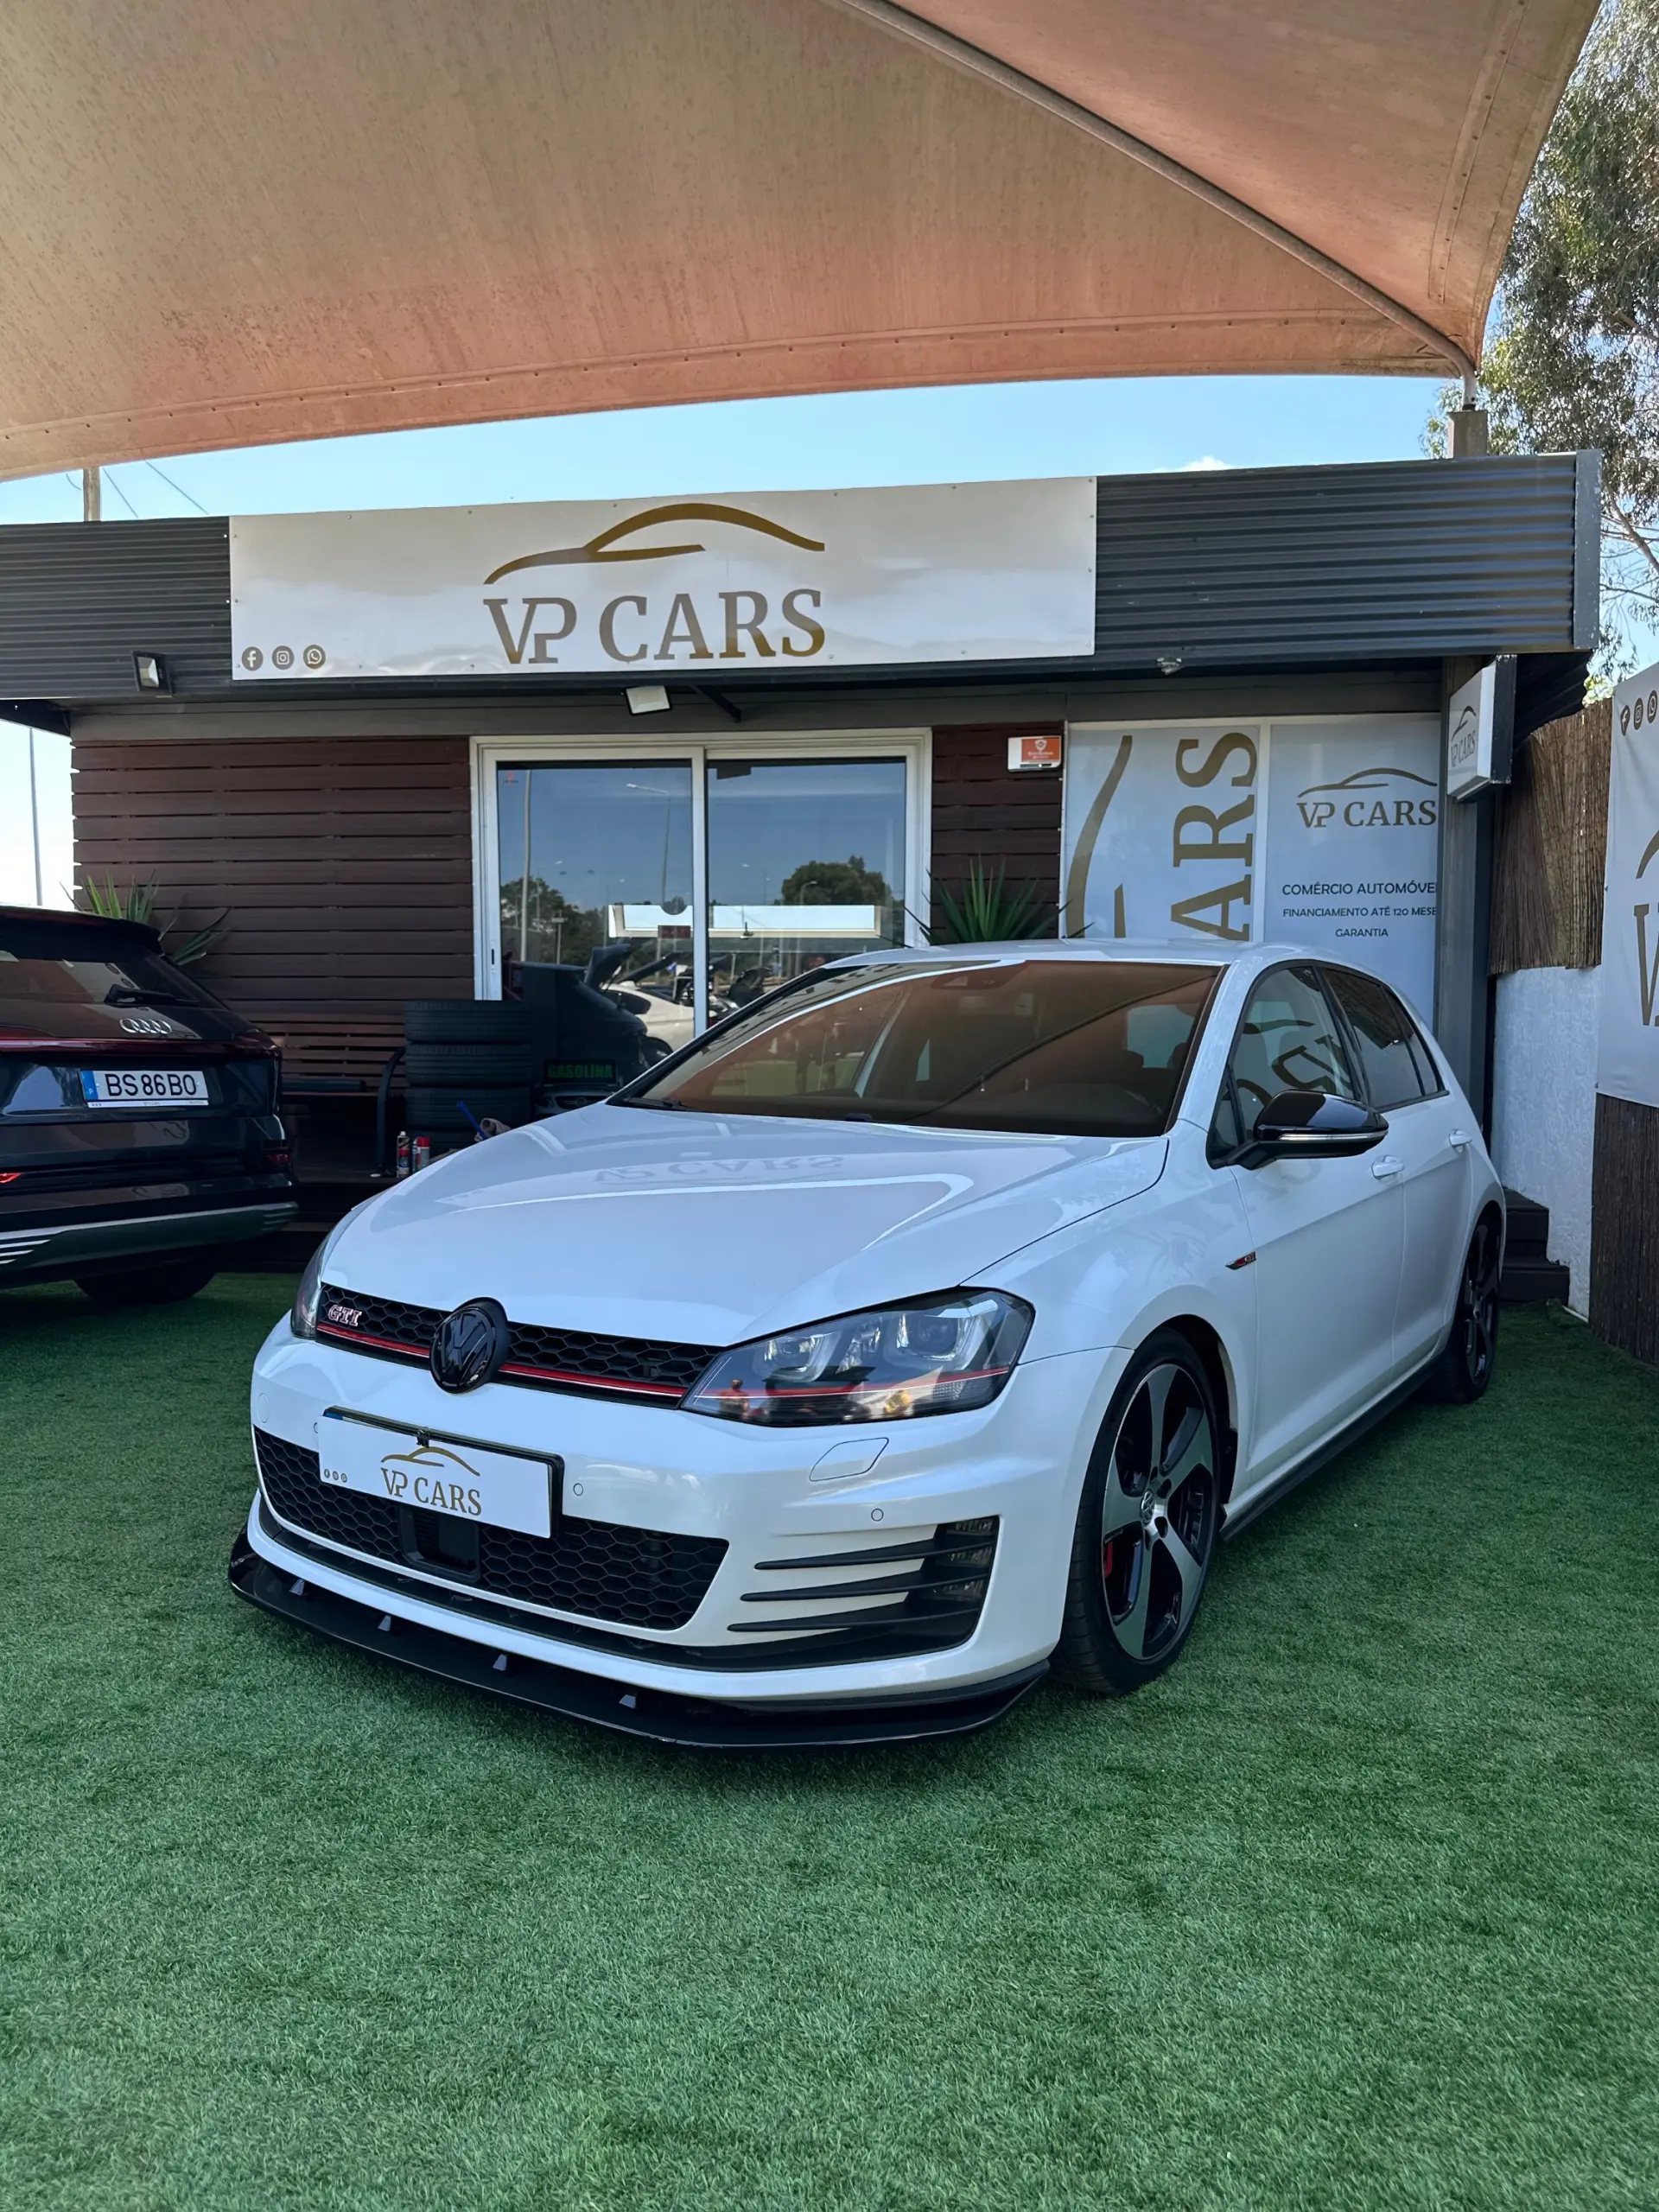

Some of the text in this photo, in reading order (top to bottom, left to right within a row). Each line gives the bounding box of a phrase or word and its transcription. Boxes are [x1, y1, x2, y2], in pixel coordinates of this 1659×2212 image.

[483, 588, 825, 664] VP CARS
[1296, 800, 1437, 828] VP CARS
[1171, 732, 1257, 942] ARS
[1282, 881, 1353, 895] COMÉRCIO
[1283, 906, 1438, 918] FINANCIAMENTO ATÉ 120 MESE
[1335, 928, 1389, 938] GARANTIA
[1633, 903, 1659, 1027] V
[547, 1063, 613, 1078] GASOLINA
[328, 1304, 363, 1327] GTI
[380, 1467, 482, 1516] VP CARS
